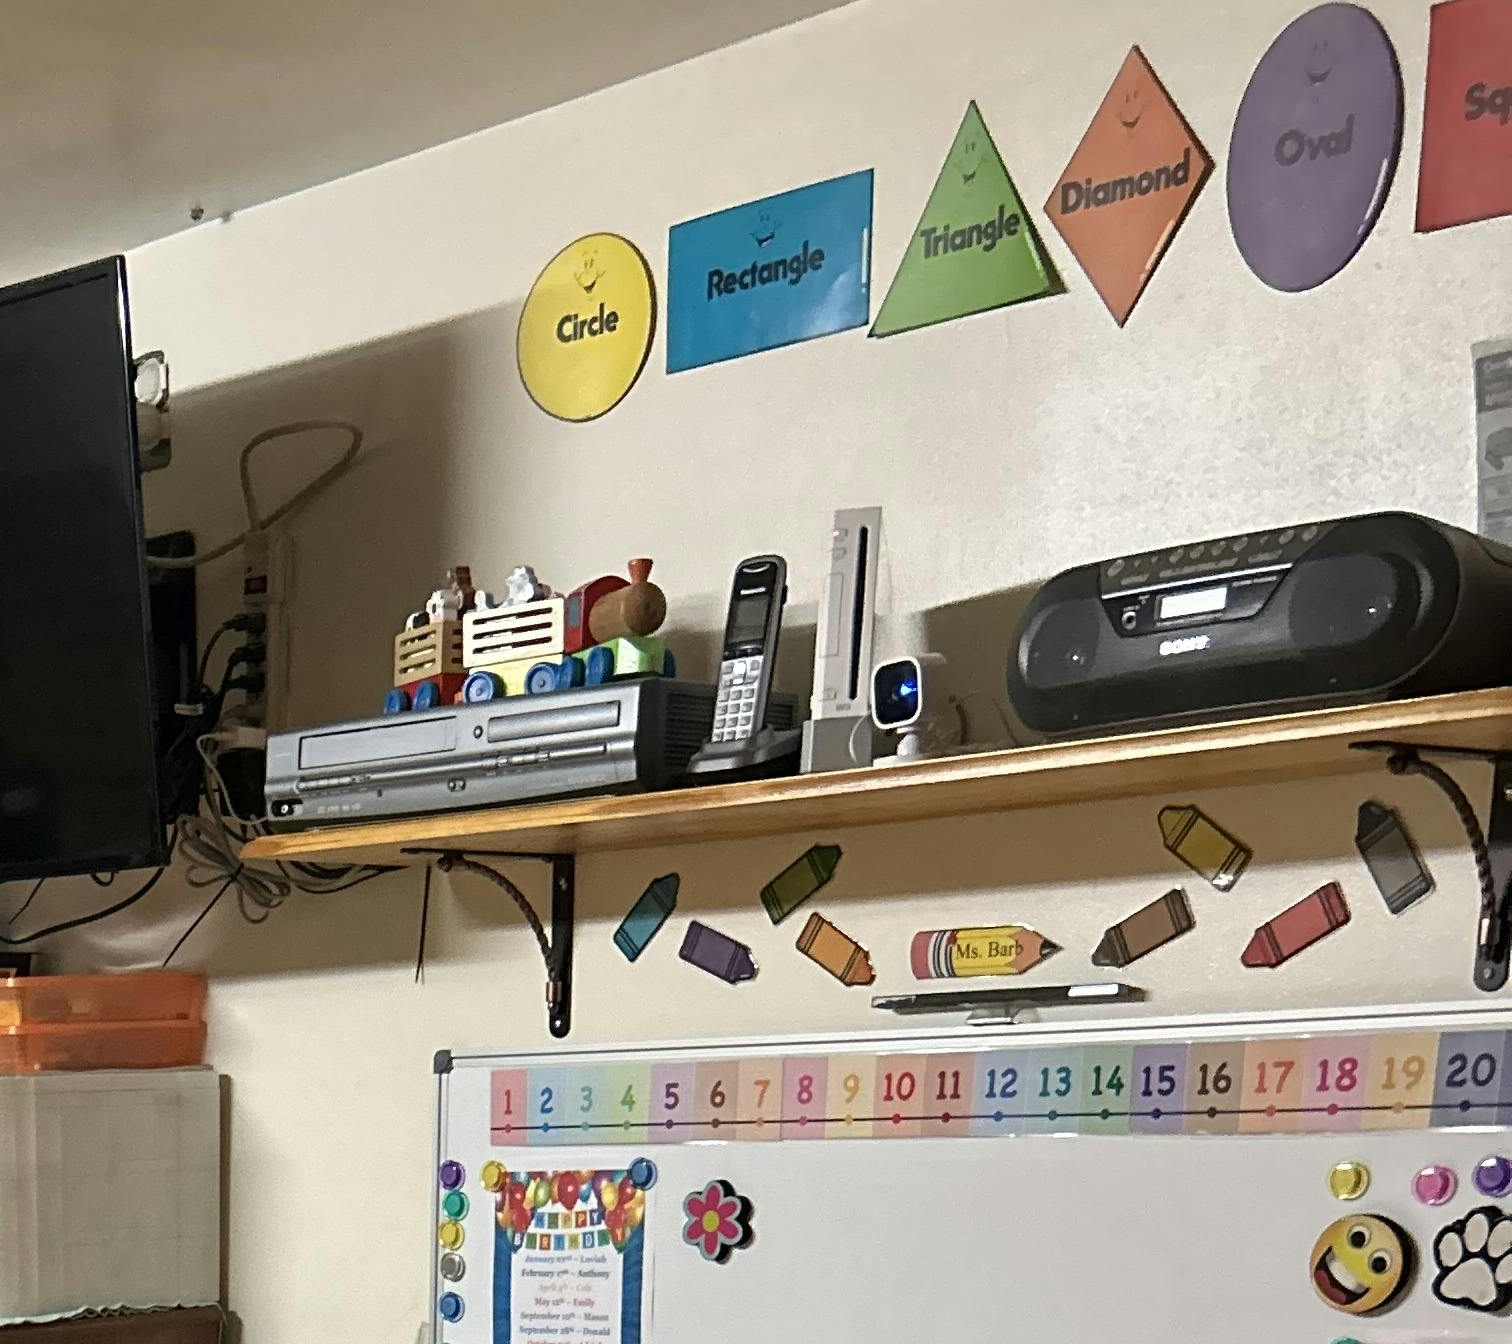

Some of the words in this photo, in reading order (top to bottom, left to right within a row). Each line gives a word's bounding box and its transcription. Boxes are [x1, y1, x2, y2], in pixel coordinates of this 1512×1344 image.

[1274, 113, 1355, 167] Oval
[1060, 148, 1190, 216] Diamond
[919, 203, 1022, 260] Triangle
[705, 240, 825, 302] Rectangle
[555, 302, 621, 345] Circle
[955, 943, 983, 960] Ms.
[987, 941, 1025, 958] Barb
[503, 1088, 512, 1115] 1
[539, 1087, 554, 1114] 2
[579, 1085, 594, 1113] 3
[620, 1084, 636, 1112] 4
[663, 1081, 680, 1110] 5
[710, 1079, 726, 1108] 6
[753, 1078, 771, 1108] 7
[797, 1074, 814, 1105] 8
[843, 1073, 859, 1104] 9
[883, 1071, 915, 1101] 10
[935, 1070, 961, 1100] 11
[985, 1067, 1018, 1098] 12
[1038, 1066, 1072, 1097] 13
[1091, 1064, 1125, 1096] 14
[1142, 1063, 1176, 1096] 15
[1197, 1061, 1232, 1095] 16
[1254, 1060, 1295, 1094] 17
[1315, 1057, 1359, 1092] 18
[1382, 1055, 1426, 1090] 19
[1445, 1052, 1497, 1088] 20
[521, 1268, 554, 1278] February
[578, 1269, 610, 1279] Anthony
[520, 1311, 560, 1321] September
[534, 1298, 549, 1307] May
[519, 1326, 558, 1335] September
[583, 1328, 610, 1336] Donald
